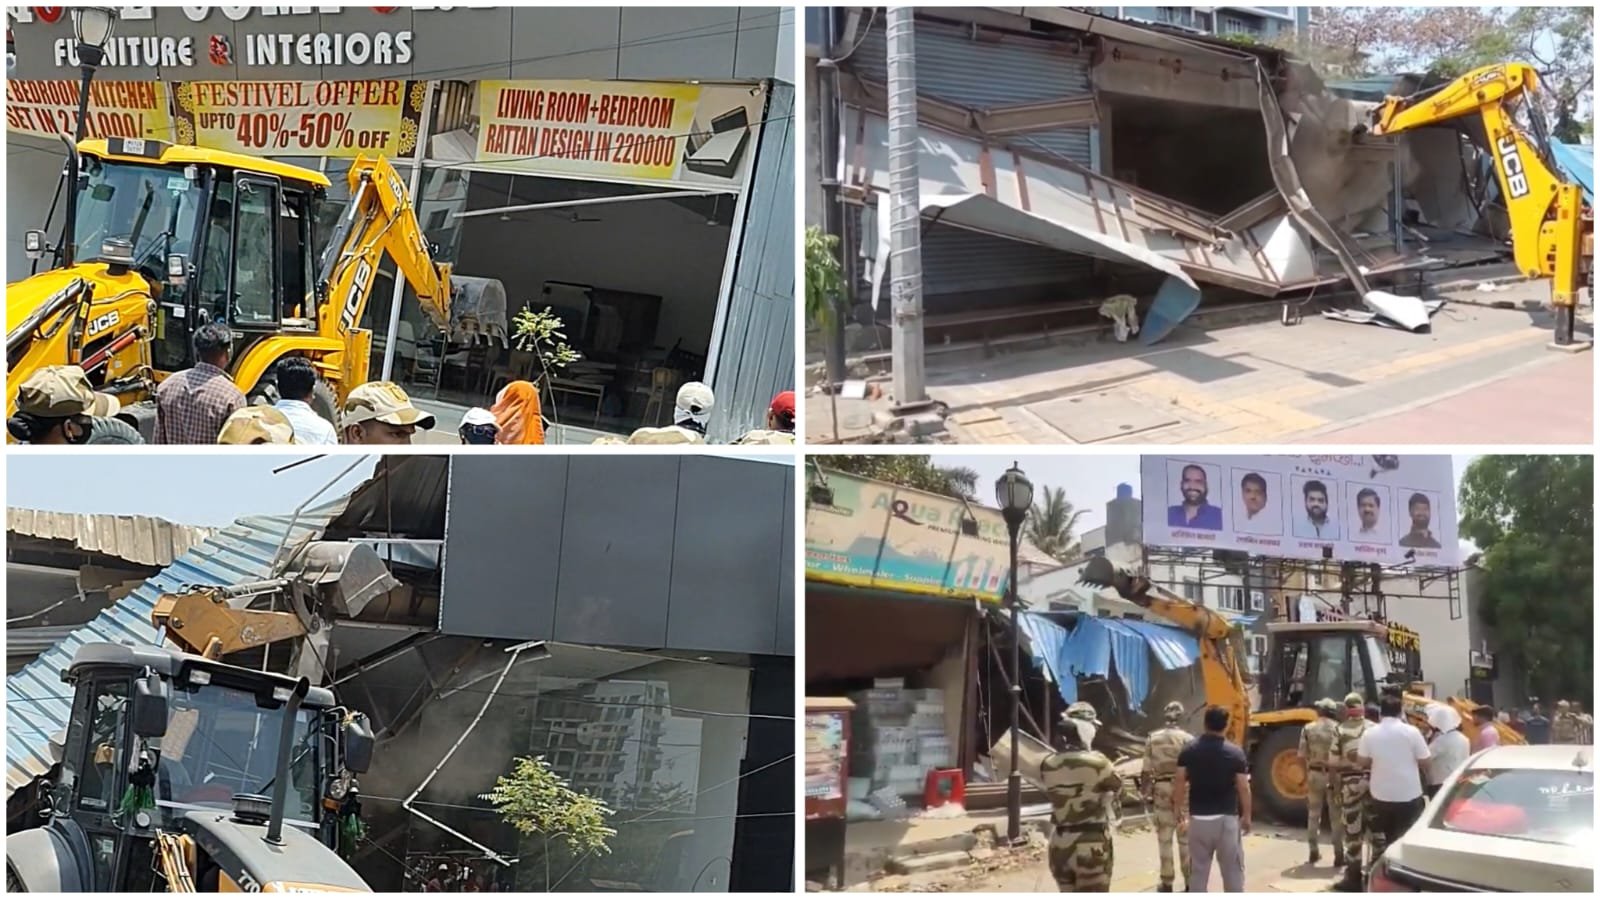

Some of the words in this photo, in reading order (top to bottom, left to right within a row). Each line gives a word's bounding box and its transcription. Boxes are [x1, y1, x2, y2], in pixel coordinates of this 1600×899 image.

[55, 36, 194, 67] FUNITURE
[246, 31, 412, 65] INTERIORS
[194, 82, 309, 107] FESTIVEL
[316, 80, 400, 106] OFFER
[497, 88, 545, 120] LIVING
[6, 105, 36, 130] SET
[34, 107, 60, 134] IN
[200, 112, 235, 129] UPTO
[237, 112, 353, 148] 40%-50%
[358, 130, 390, 148] OFF
[485, 124, 538, 155] RATTAN
[540, 128, 595, 161] DESIGN
[597, 132, 612, 161] IN
[612, 133, 676, 167] 220000
[1497, 136, 1528, 199] JCB
[342, 258, 371, 328] JCB
[88, 310, 120, 335] JCB
[238, 868, 260, 893] 770
